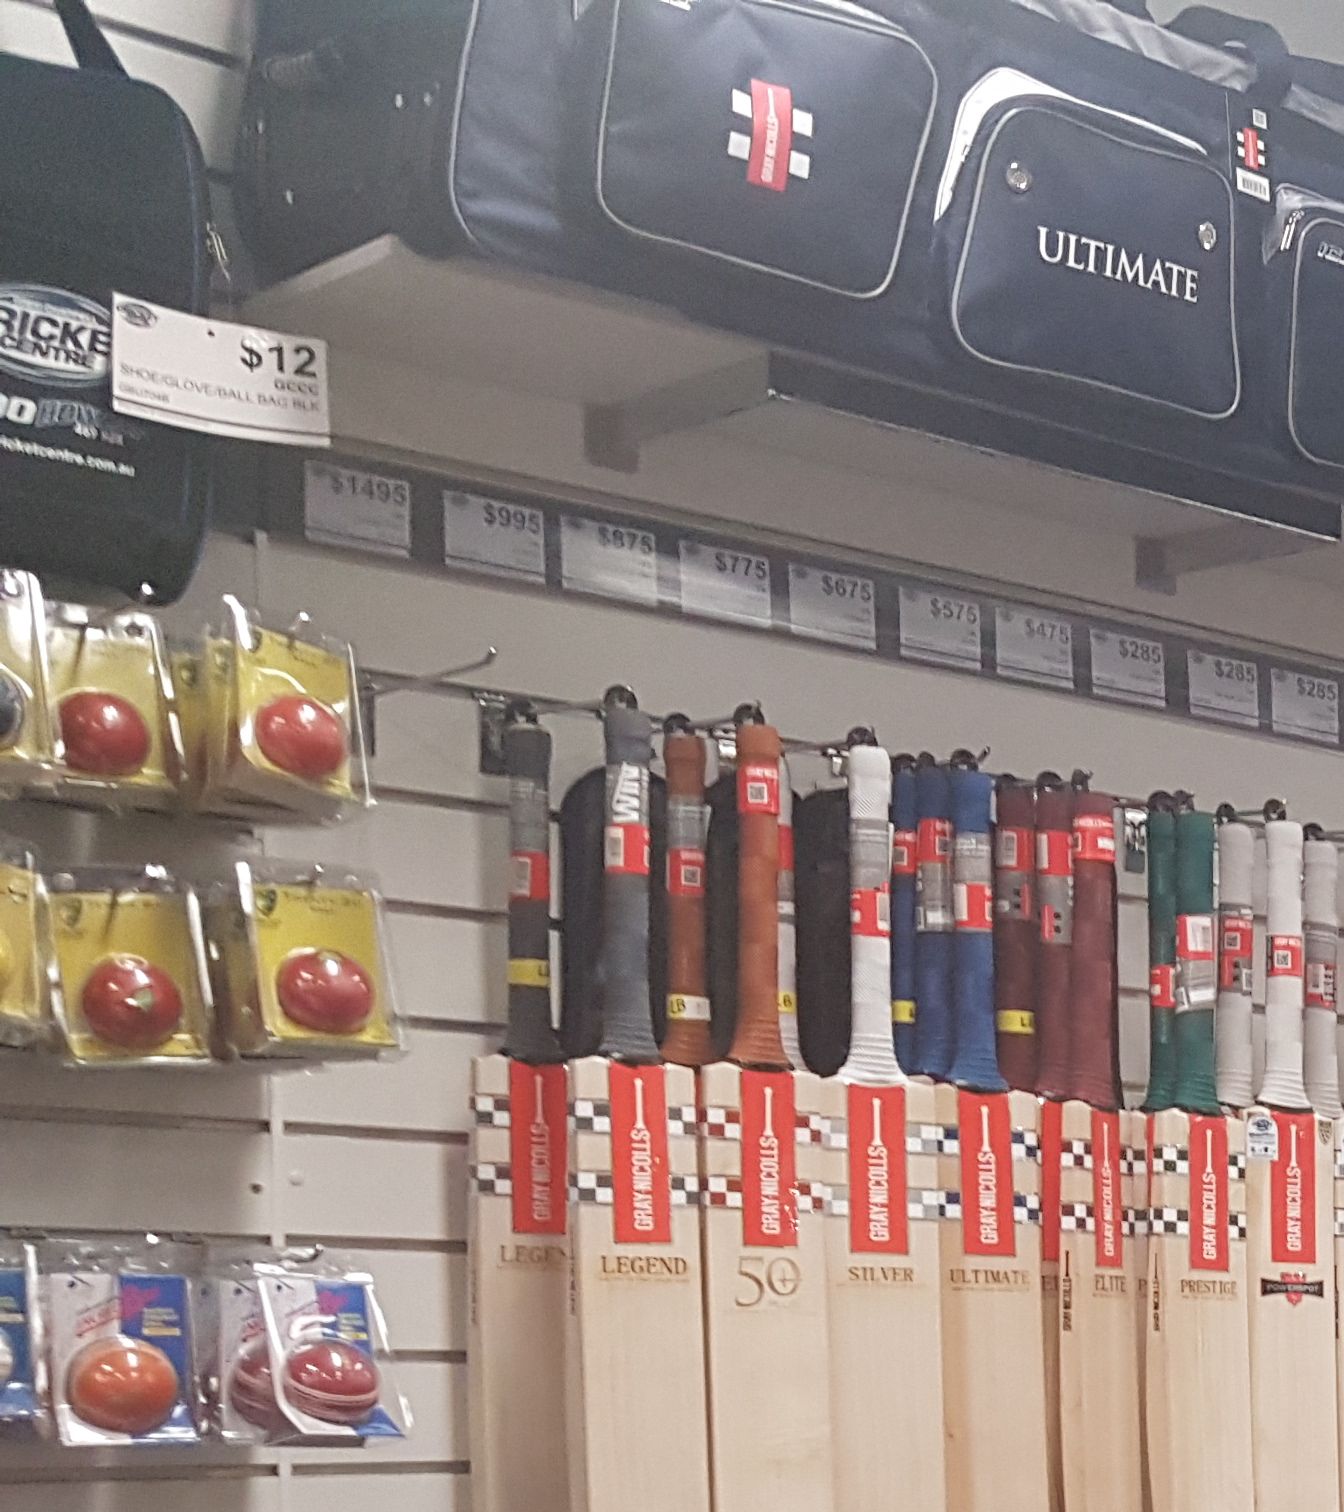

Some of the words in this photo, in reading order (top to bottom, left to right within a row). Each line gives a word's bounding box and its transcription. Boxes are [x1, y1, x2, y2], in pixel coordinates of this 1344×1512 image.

[1037, 225, 1199, 304] ULTIMATE
[0, 304, 111, 356] RICKE
[241, 336, 318, 379] $12
[482, 502, 541, 535] $995
[713, 551, 767, 581] $775
[820, 574, 873, 602] $675
[1024, 617, 1070, 643] $475
[1119, 639, 1163, 666] $285
[1213, 658, 1257, 685] $285
[1296, 677, 1338, 703] $285
[630, 1126, 655, 1232] GRAY-NICOLLS
[759, 1135, 781, 1236] GRAY-NICOLLS
[866, 1144, 891, 1242] GRAY-NICOLLS
[977, 1150, 999, 1245] GRAY-NICOLLS
[1286, 1165, 1302, 1252] GRAY-NICOLLS
[1202, 1172, 1218, 1260] GRAY-NICOLLS
[500, 1244, 565, 1265] LEGEN
[600, 1254, 688, 1275] LEGEND
[735, 1255, 800, 1308] 50
[847, 1265, 915, 1283] SILVER
[950, 1268, 1031, 1286] ULTIMATE
[1094, 1274, 1127, 1293] ELITE
[1180, 1278, 1238, 1296] PRESTIGE
